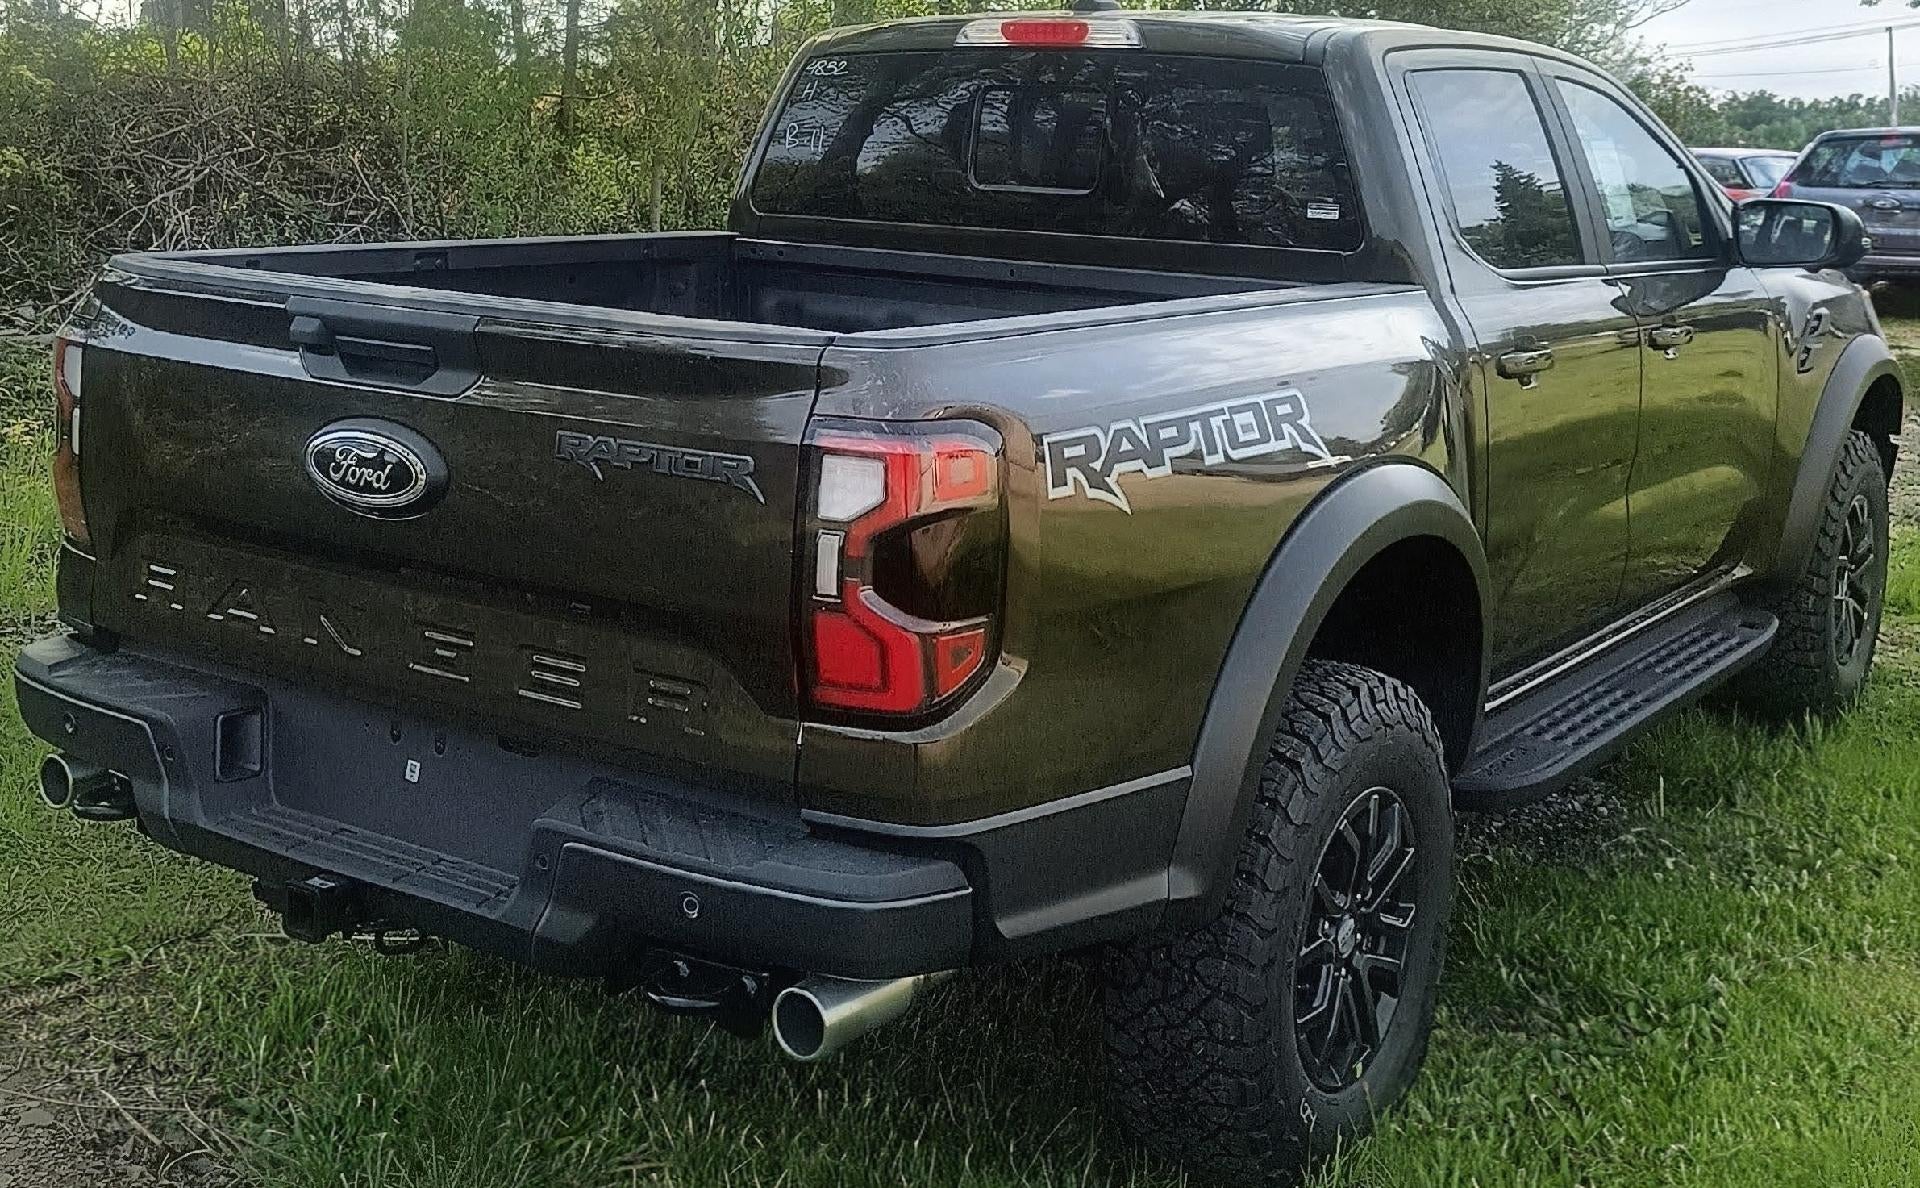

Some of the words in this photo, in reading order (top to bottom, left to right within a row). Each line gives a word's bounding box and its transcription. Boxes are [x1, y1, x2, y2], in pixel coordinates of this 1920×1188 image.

[329, 445, 393, 491] Ford
[556, 430, 766, 505] RAPTOR
[1043, 388, 1337, 515] RAPTOR
